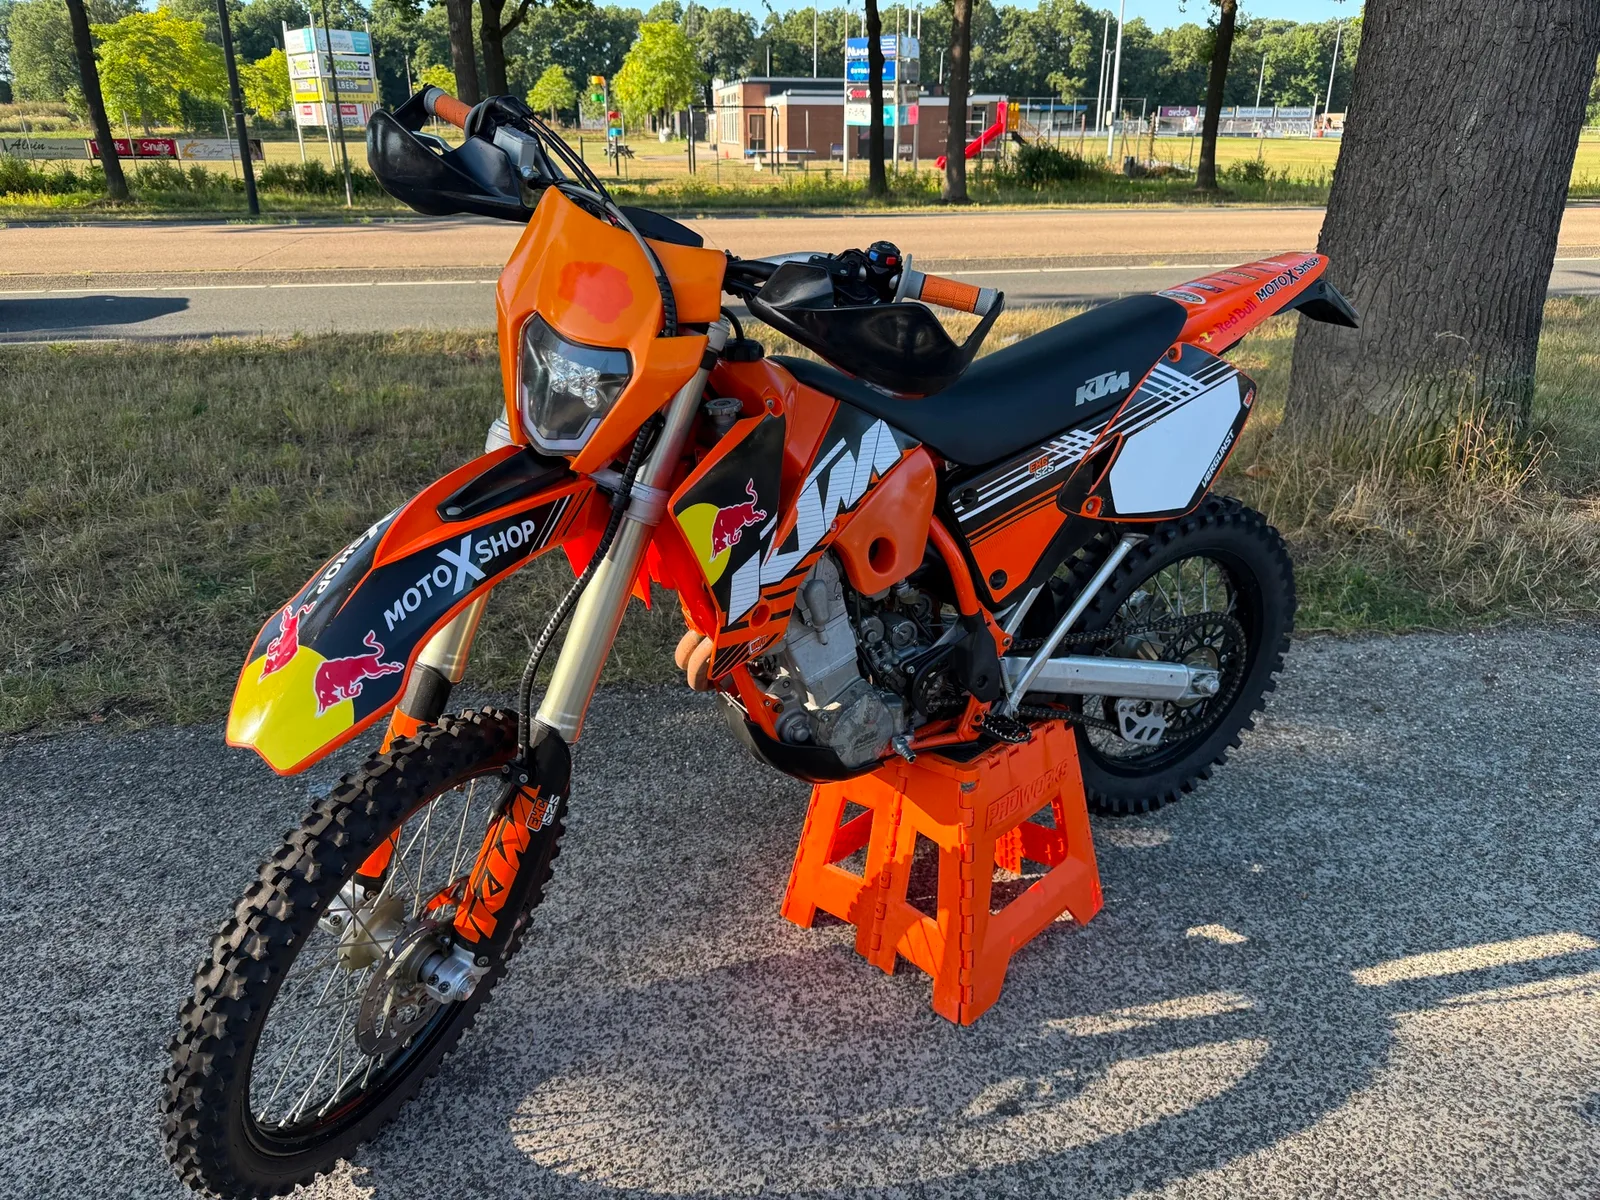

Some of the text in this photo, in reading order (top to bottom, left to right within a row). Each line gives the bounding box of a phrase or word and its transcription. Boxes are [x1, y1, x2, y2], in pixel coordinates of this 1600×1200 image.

[1216, 298, 1258, 335] Red Bull
[1075, 371, 1130, 407] KTM
[728, 418, 902, 626] KTM
